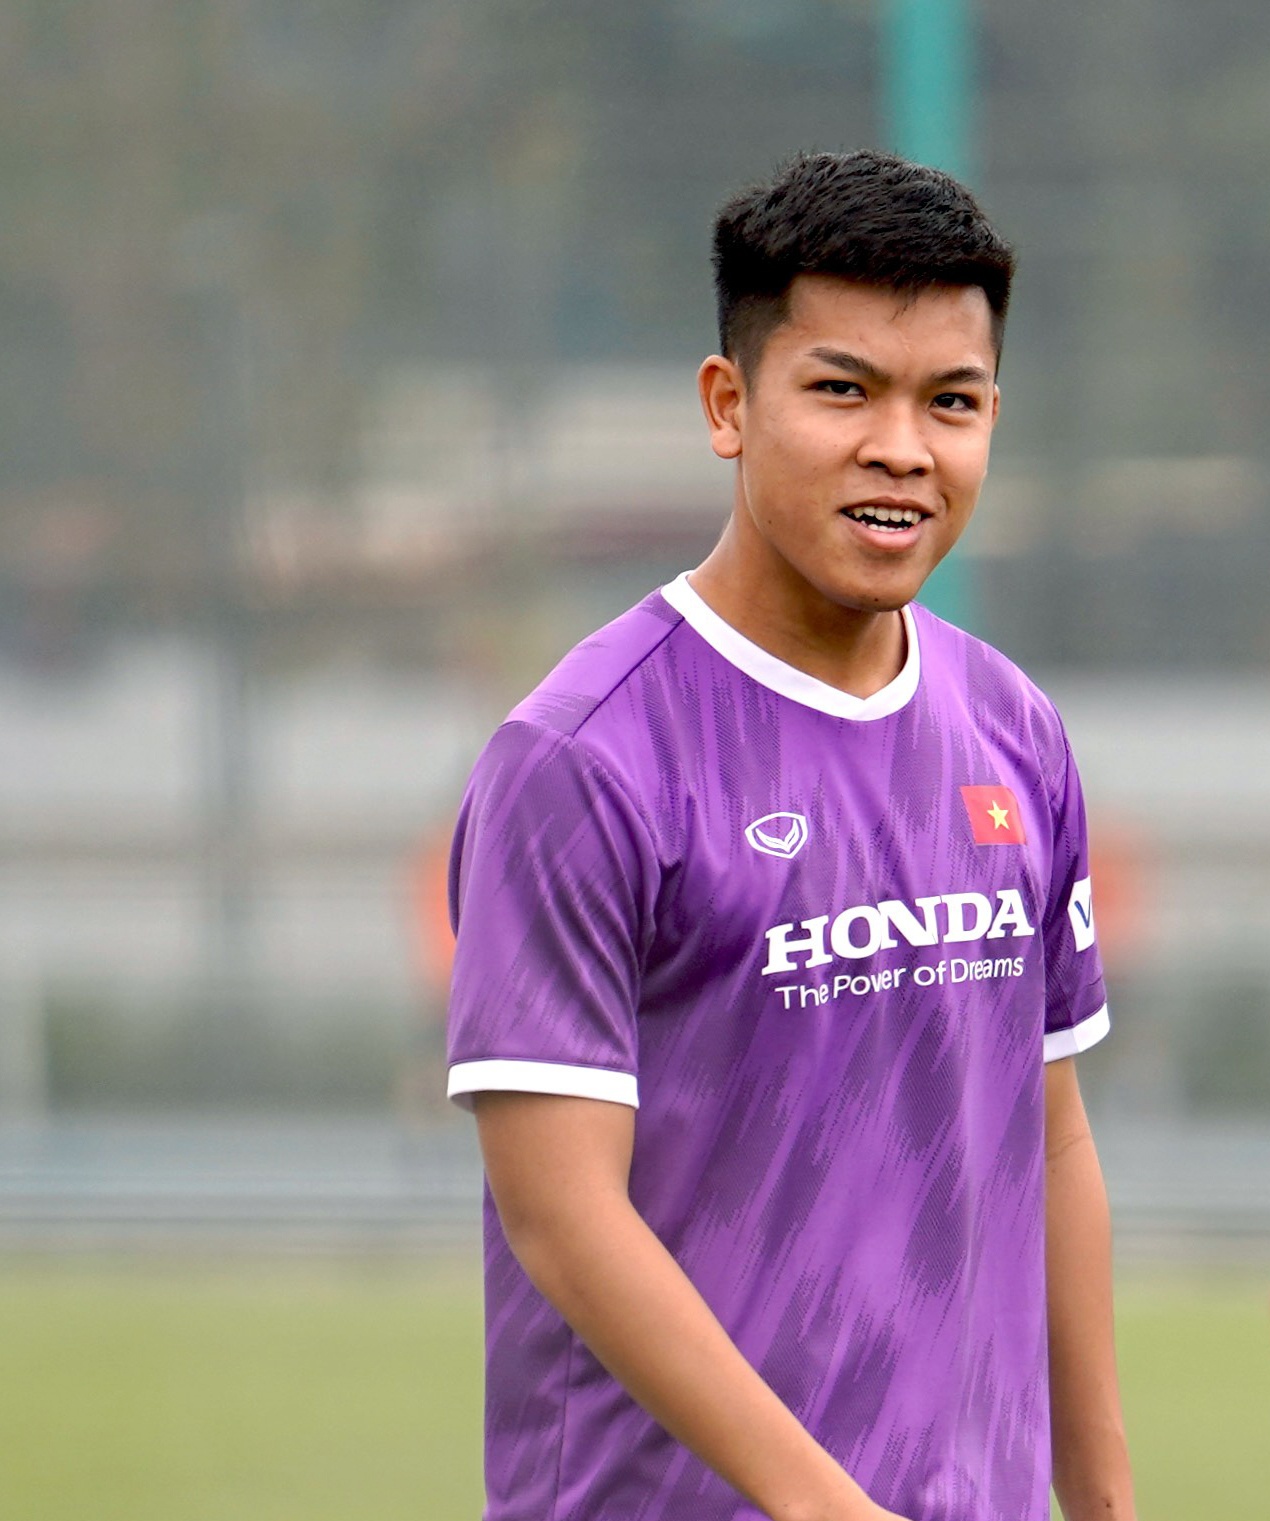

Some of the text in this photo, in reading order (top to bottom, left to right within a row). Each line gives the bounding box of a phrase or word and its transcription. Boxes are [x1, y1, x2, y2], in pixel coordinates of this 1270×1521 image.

[761, 889, 1035, 975] HONDA
[775, 982, 829, 1010] The
[913, 960, 947, 987] of
[951, 956, 1025, 984] Dreams
